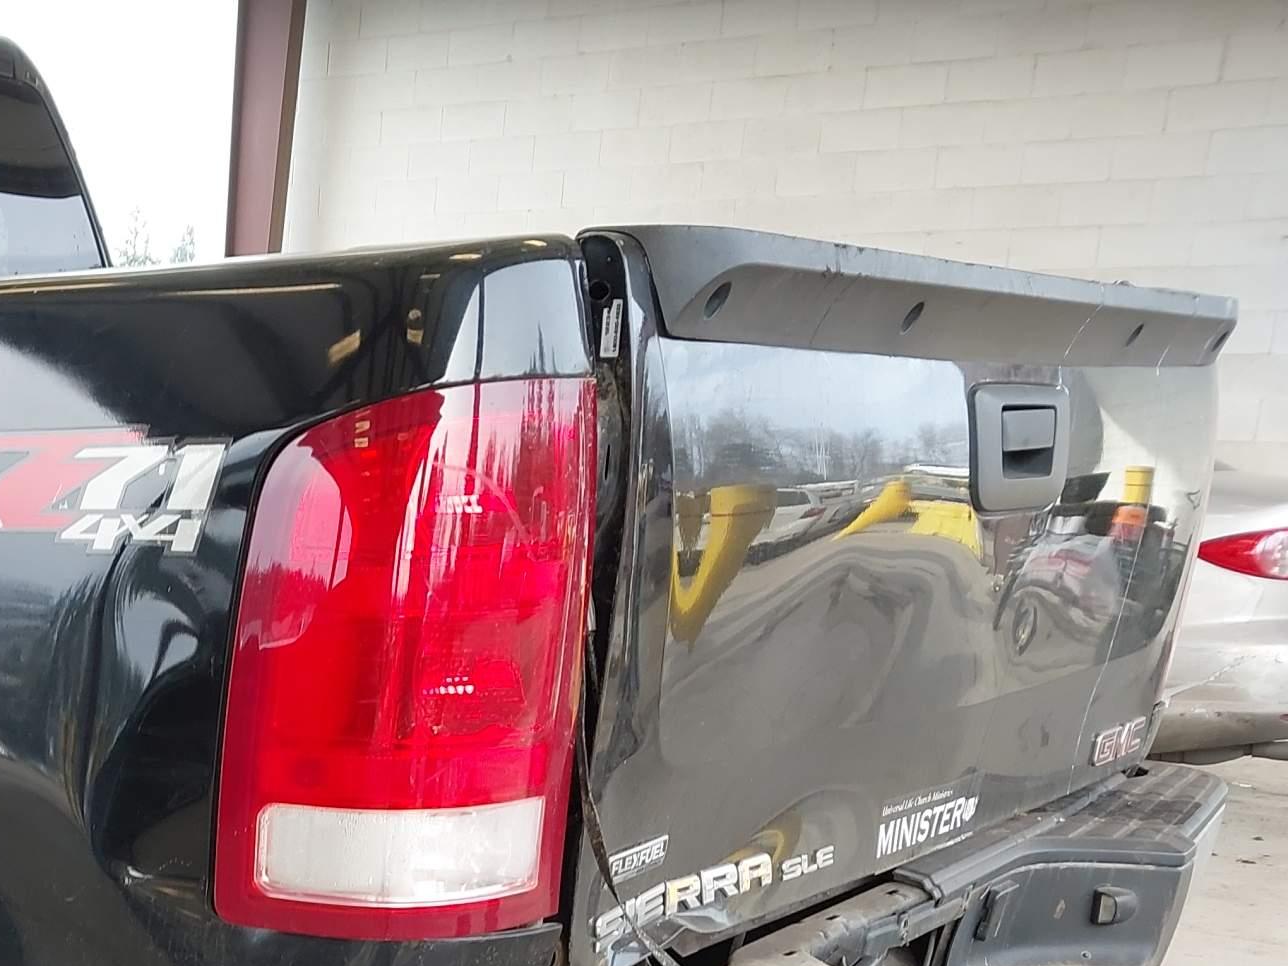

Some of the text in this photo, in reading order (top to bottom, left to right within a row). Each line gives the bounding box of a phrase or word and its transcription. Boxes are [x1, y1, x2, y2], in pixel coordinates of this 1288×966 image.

[1094, 716, 1147, 766] GMC
[876, 796, 966, 859] MINISTER
[611, 842, 665, 877] FLEXFUEL
[594, 852, 773, 953] SIERRA
[781, 845, 835, 881] SLE
